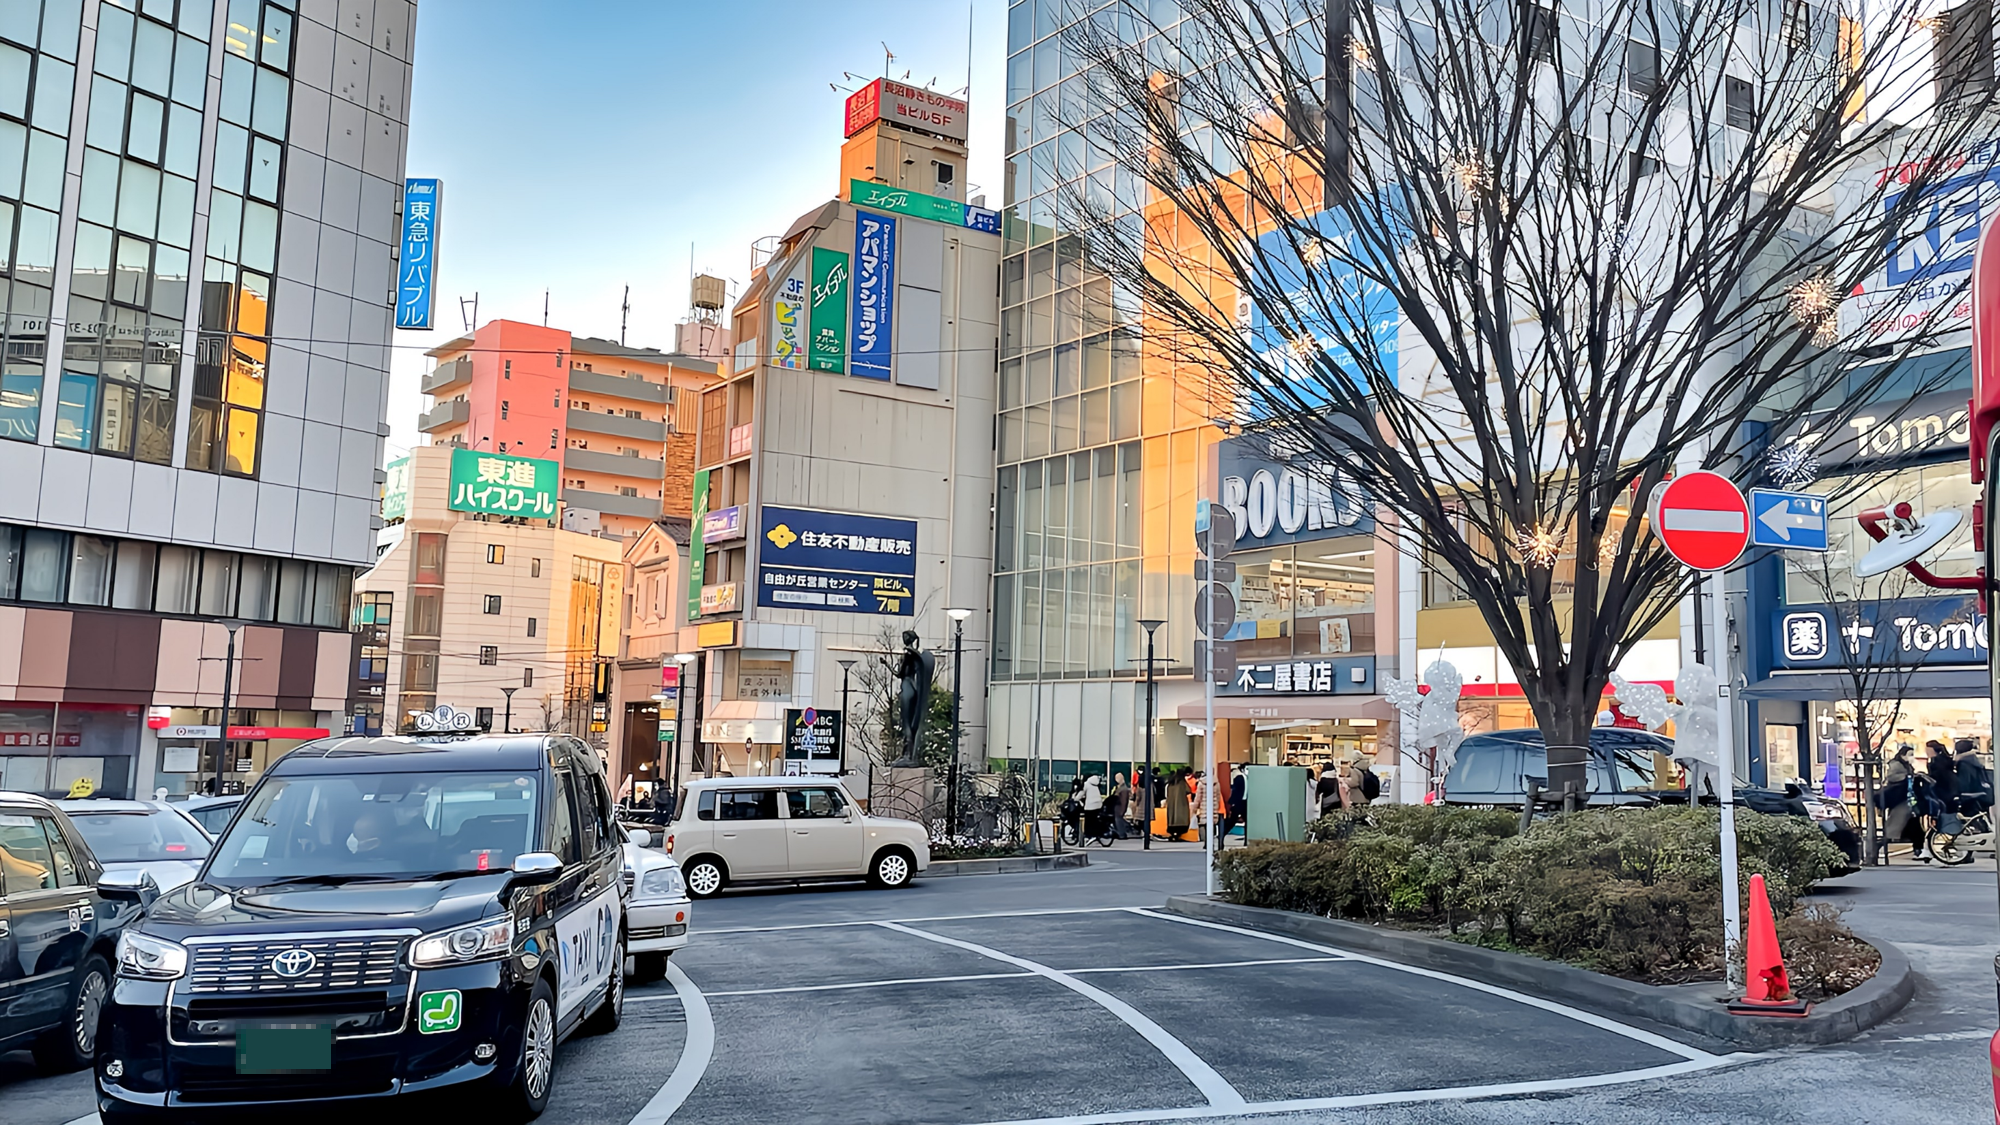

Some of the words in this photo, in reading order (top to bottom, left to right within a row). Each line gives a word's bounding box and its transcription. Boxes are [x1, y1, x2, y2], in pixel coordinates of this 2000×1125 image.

[897, 103, 952, 126] 当ビル5F
[863, 190, 909, 208] エイブル
[402, 201, 431, 325] 東急リバブル
[787, 278, 804, 294] 3F
[813, 263, 848, 308] エイブル
[859, 219, 880, 352] アパマンショップ
[476, 457, 535, 488] 東進
[454, 483, 554, 514] ハイスクール
[1223, 451, 1364, 541] BOOKS
[801, 531, 911, 555] 住友不動産販売
[764, 573, 869, 590] 自由が丘営業センター
[1790, 620, 1820, 653] 薬
[1237, 661, 1332, 692] 不二屋書店
